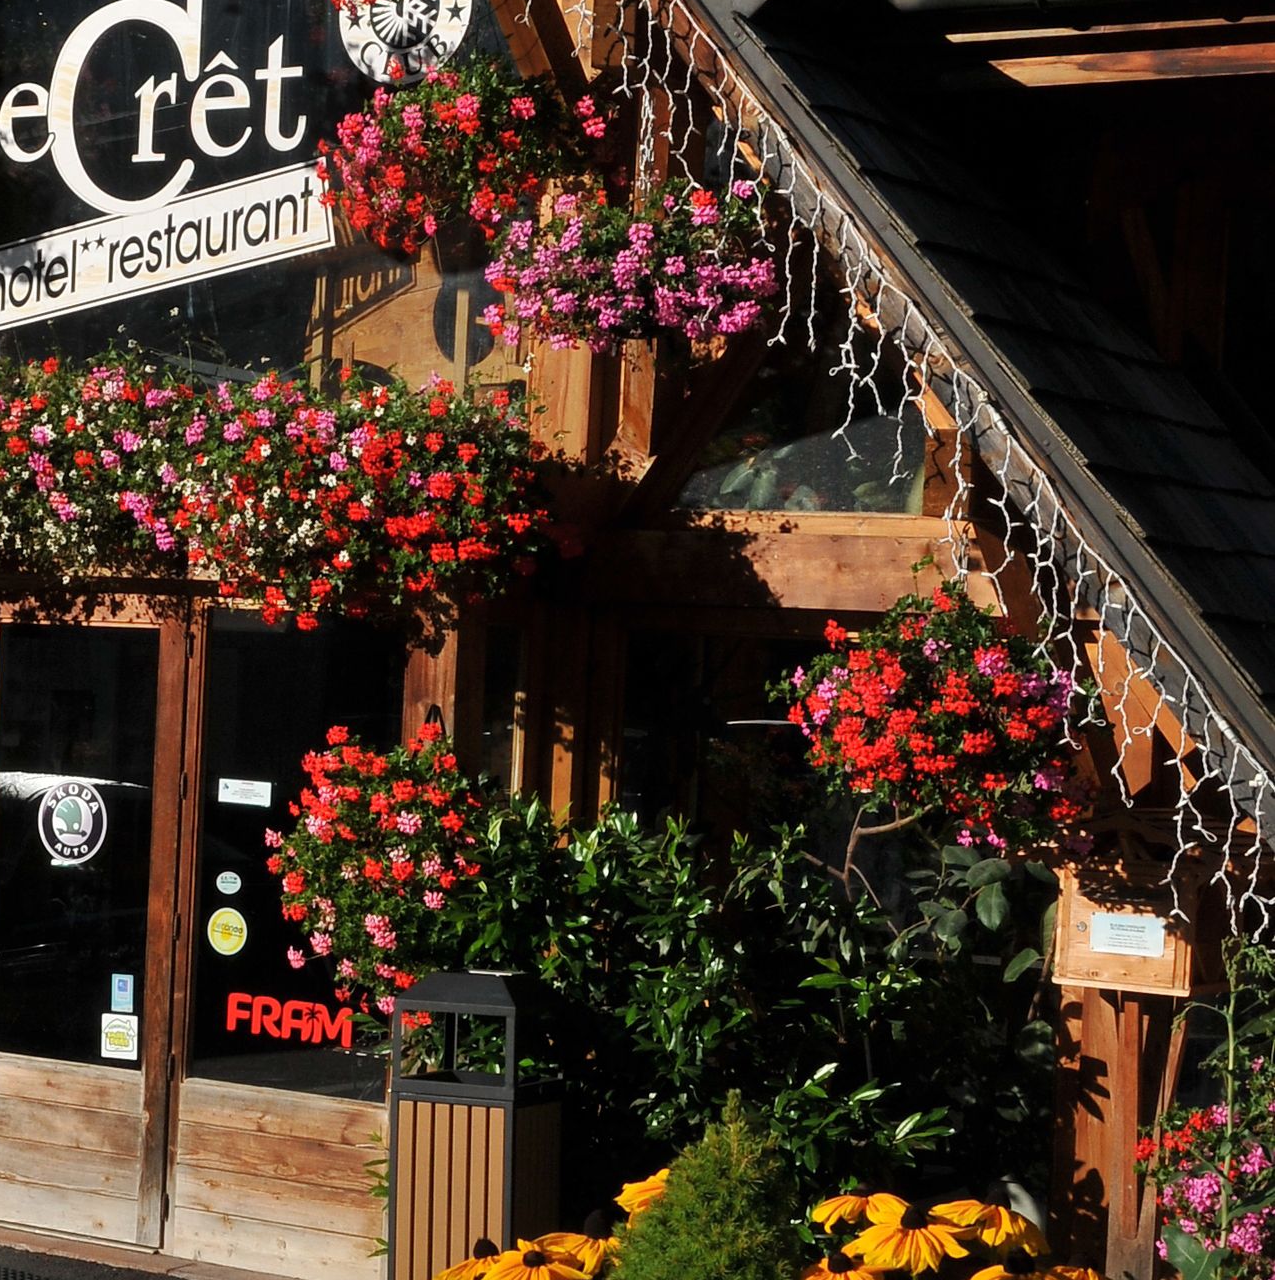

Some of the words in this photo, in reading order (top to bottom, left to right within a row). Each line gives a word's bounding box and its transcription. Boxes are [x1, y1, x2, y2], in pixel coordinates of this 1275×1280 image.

[106, 176, 313, 284] restaurant
[53, 842, 89, 857] AUTO
[226, 991, 354, 1048] FRAM
